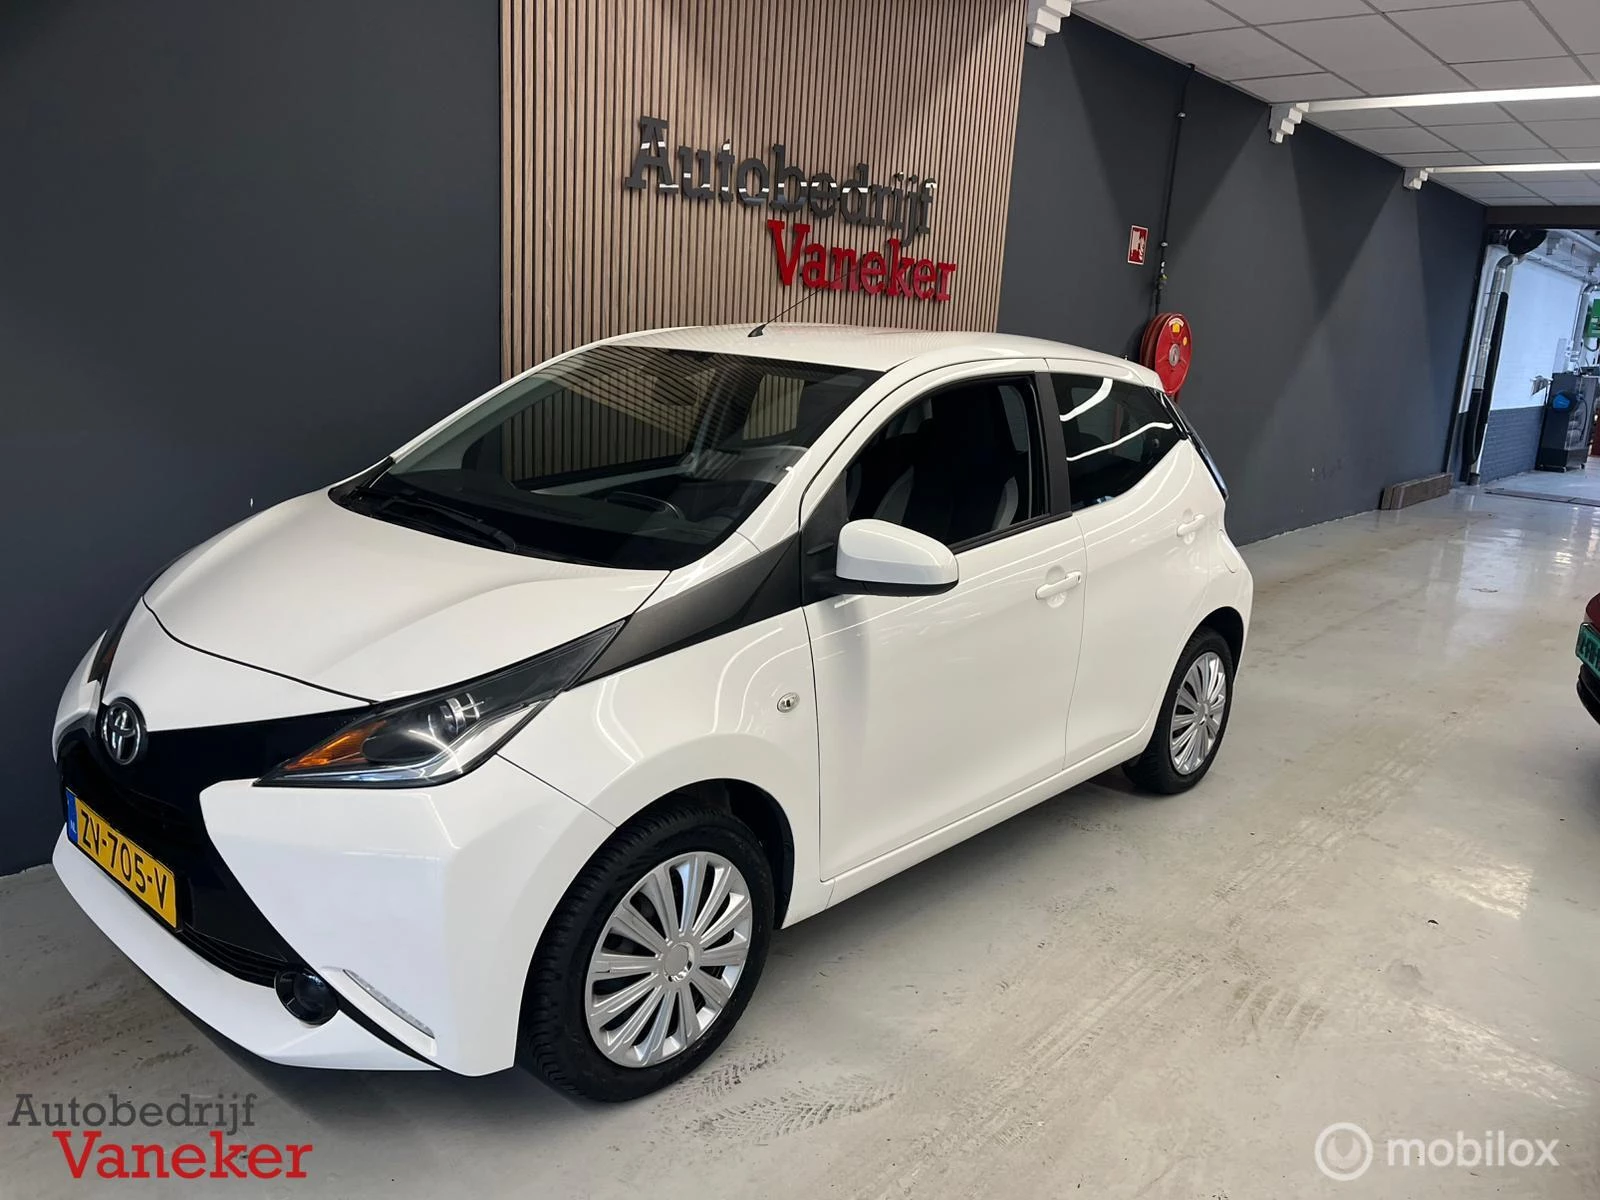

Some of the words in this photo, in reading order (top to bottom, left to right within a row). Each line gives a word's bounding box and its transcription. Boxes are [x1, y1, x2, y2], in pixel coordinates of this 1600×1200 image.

[625, 115, 938, 247] Autobedrijf
[767, 219, 957, 301] Vaneker
[81, 808, 168, 910] ZN-705-V
